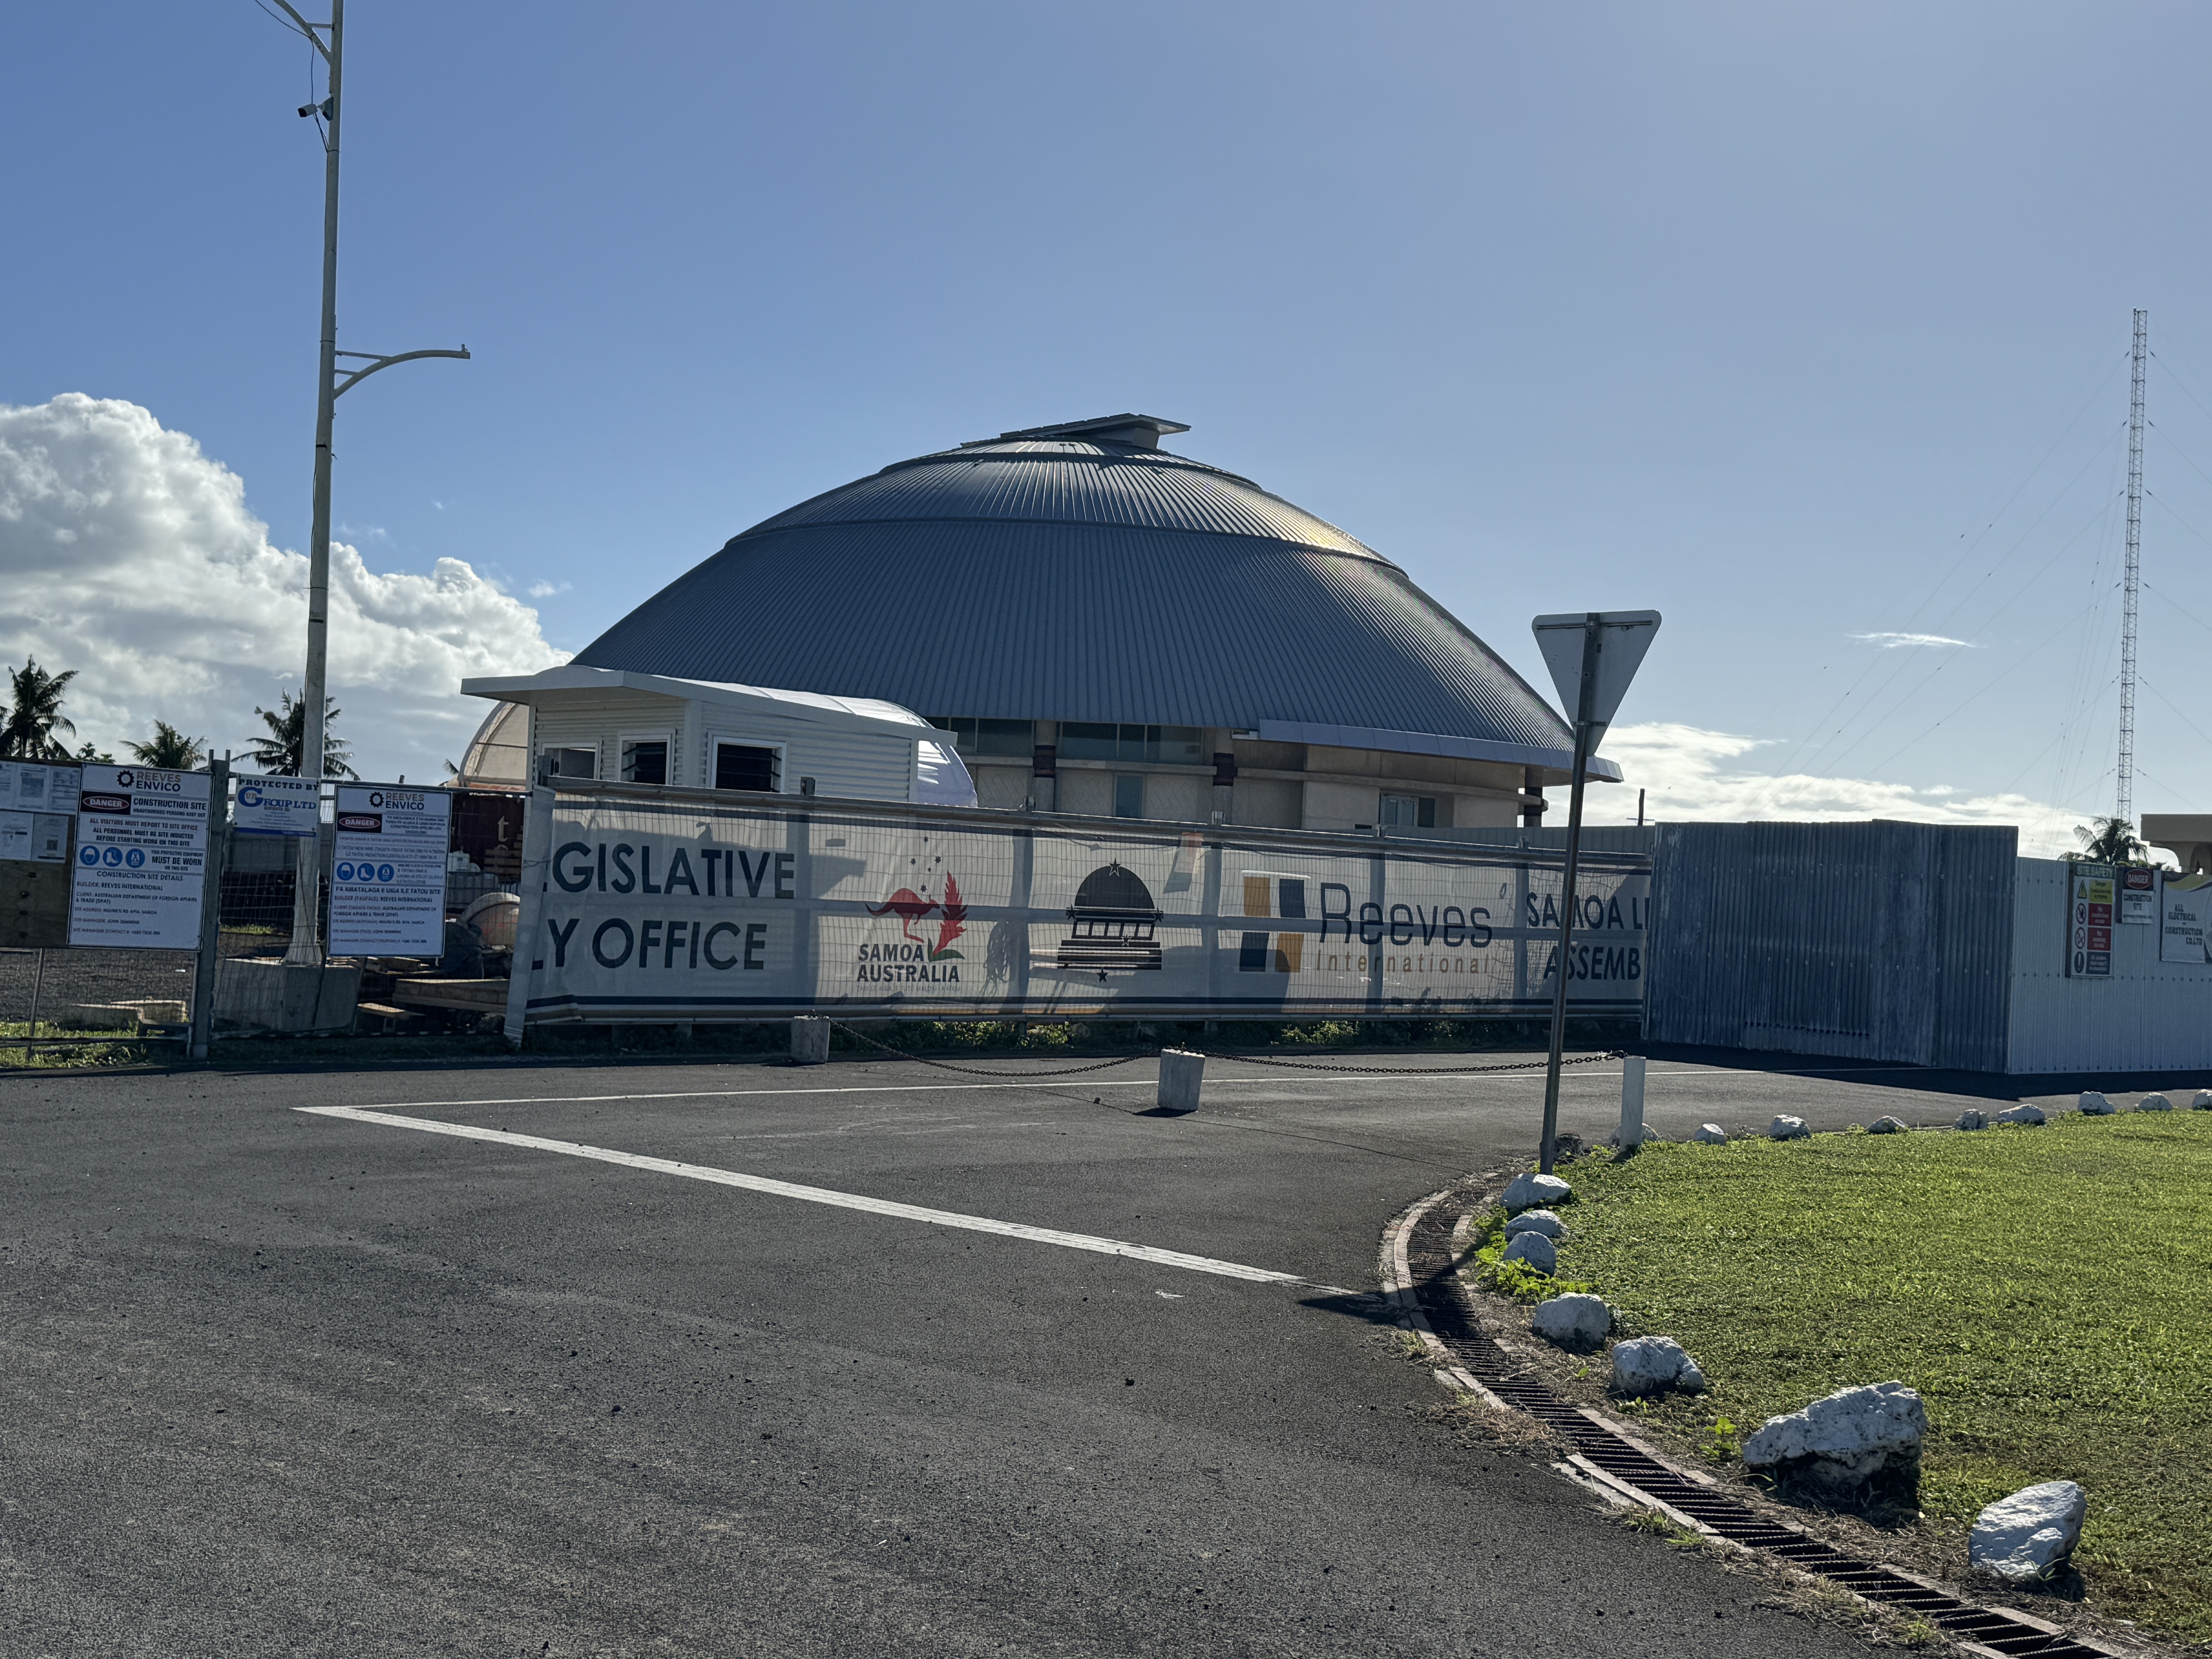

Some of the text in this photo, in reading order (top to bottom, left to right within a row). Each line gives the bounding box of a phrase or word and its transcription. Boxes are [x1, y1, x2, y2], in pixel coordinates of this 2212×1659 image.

[136, 771, 181, 782] REEVES
[136, 780, 180, 792] ENVICO
[239, 779, 302, 790] PROTECTED
[386, 792, 424, 802] REEVES
[89, 799, 122, 807] DANGER
[134, 798, 206, 810] CONSTRUCTION SITE
[294, 800, 316, 809] LTD
[386, 801, 424, 810] ENVICO
[152, 856, 170, 864] MUST
[183, 857, 202, 866] WORN
[97, 871, 146, 879] CONSTRUCTION
[543, 841, 795, 900] GISLATIVE
[2076, 866, 2113, 878] SITE SAFETY
[2127, 873, 2149, 884] DANGER
[2123, 894, 2152, 902] CONSTRUCTION
[2174, 903, 2184, 912] ALL
[1319, 882, 1492, 948] Reeves
[2168, 912, 2197, 921] ELECTRICAL
[2165, 926, 2203, 936] CONSTRUCTION
[532, 917, 768, 970] Y OFFICE
[858, 943, 925, 962] SAMOA
[1317, 949, 1489, 974] International
[1544, 945, 1641, 980] ASSEMB
[857, 965, 960, 982] AUSTRALIA
